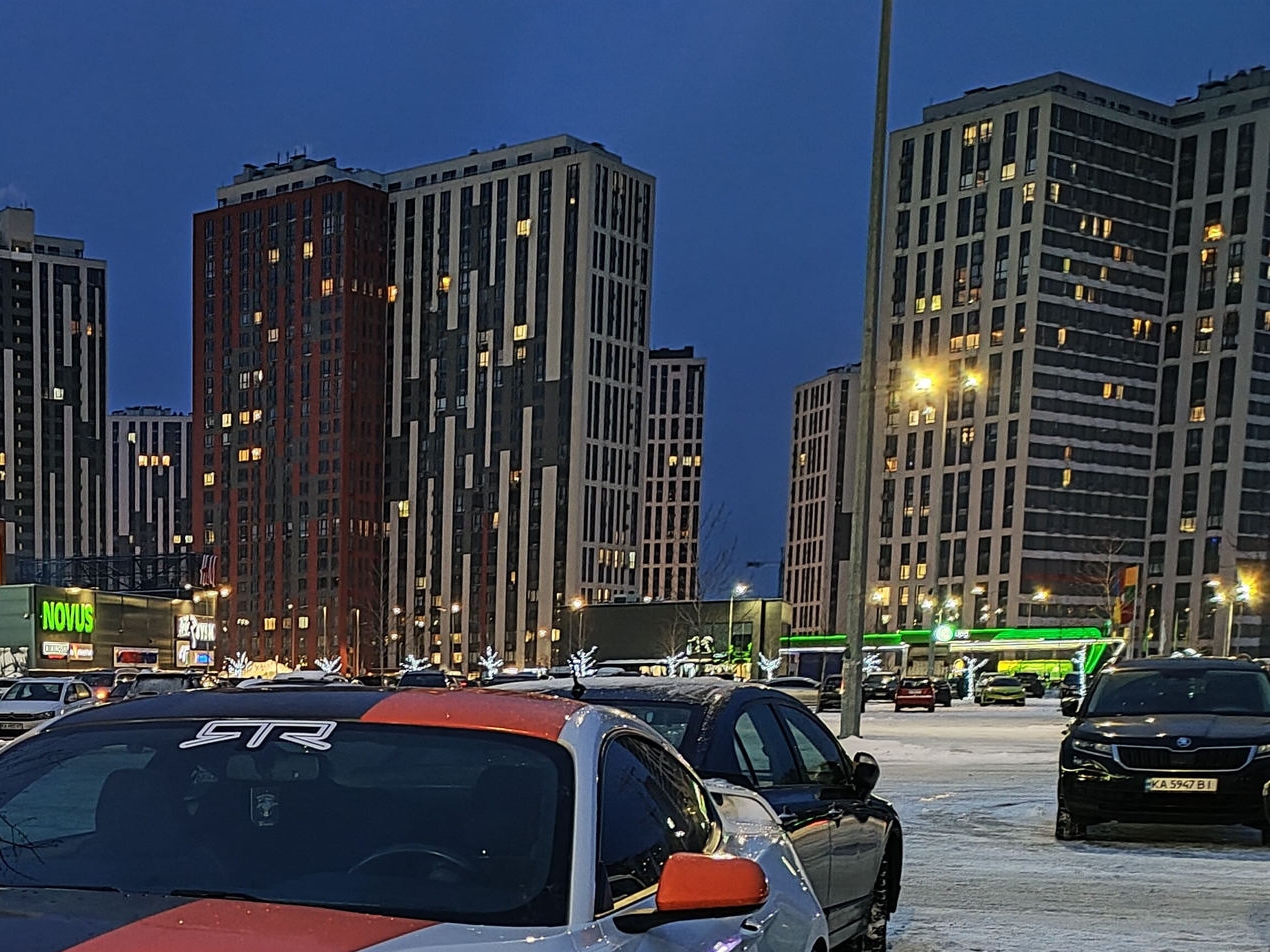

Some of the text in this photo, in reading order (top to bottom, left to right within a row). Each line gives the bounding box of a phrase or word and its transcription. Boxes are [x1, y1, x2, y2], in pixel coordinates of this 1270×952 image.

[43, 601, 94, 633] NOVUS
[1152, 780, 1167, 789] KA
[1170, 780, 1195, 789] 5947
